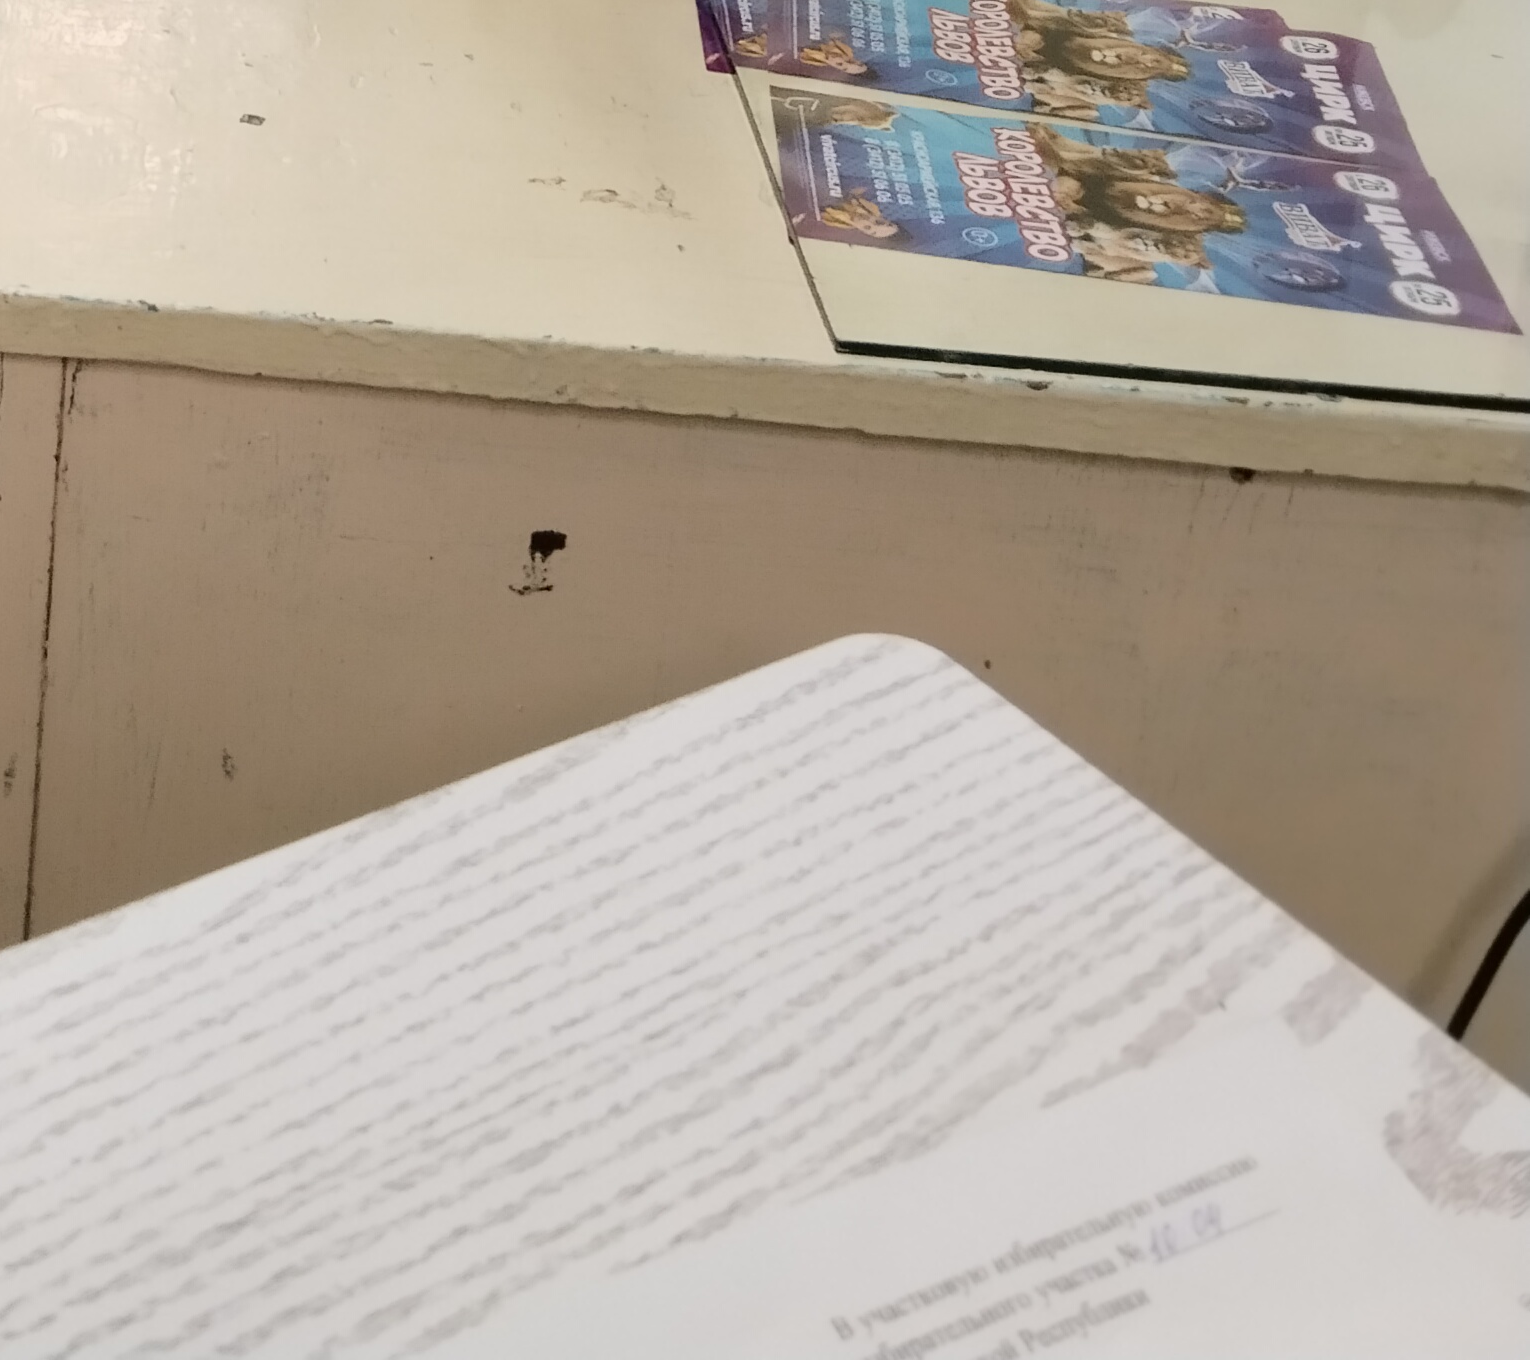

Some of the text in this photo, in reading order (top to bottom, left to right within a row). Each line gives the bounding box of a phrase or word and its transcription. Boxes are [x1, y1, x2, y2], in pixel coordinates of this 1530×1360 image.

[927, 8, 974, 64] ЛЬВОВ
[1300, 41, 1327, 54] 26
[1300, 64, 1356, 125] ЦИРК
[819, 135, 843, 198] vivatcircus.ru
[1335, 134, 1366, 148] 25
[952, 151, 1013, 218] ЛЬВОВ
[991, 128, 1071, 263] КОРОЛЕВСТВО
[1356, 178, 1389, 193] 26
[1362, 203, 1435, 280] ЦИРК
[1415, 289, 1451, 308] 25
[831, 1155, 1259, 1341] В участковую избирательную комиссию
[863, 1291, 1032, 1360] бирательного
[1034, 1257, 1118, 1309] участка
[1116, 1242, 1146, 1268] №
[1018, 1287, 1151, 1353] Республики
